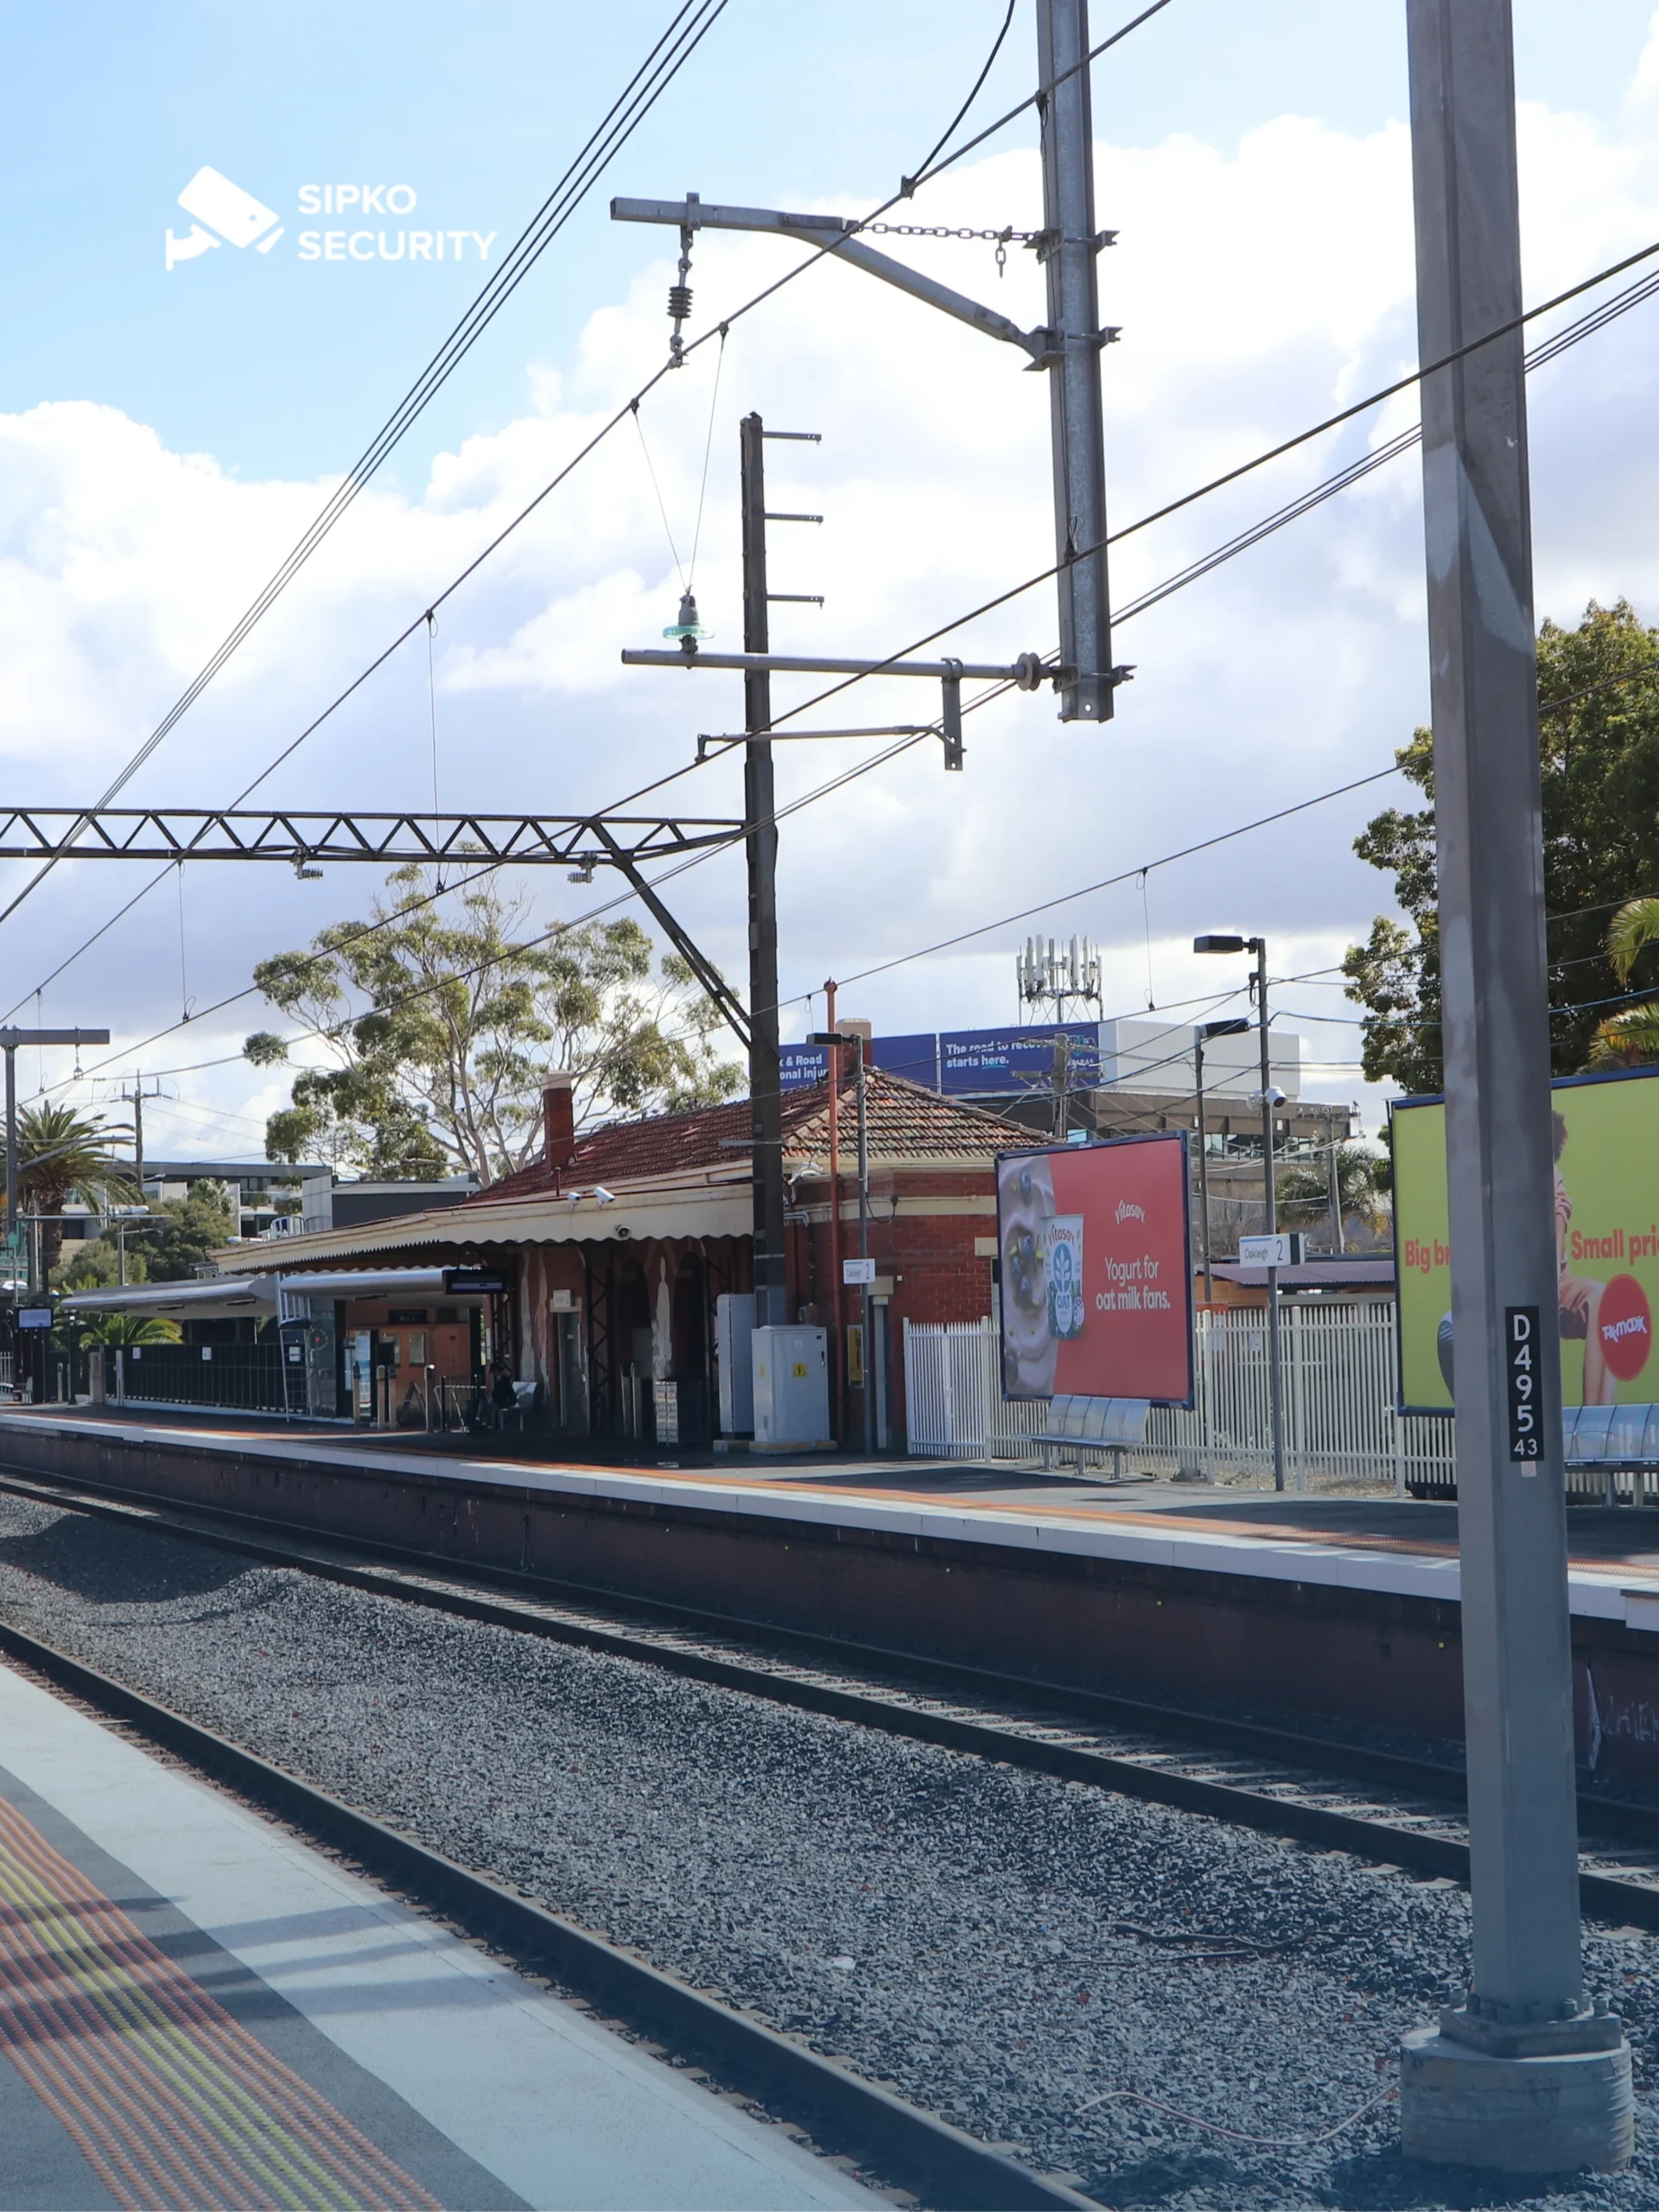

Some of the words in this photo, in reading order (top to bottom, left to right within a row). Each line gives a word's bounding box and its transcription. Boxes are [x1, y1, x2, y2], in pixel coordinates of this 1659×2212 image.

[946, 1043, 967, 1054] The
[969, 1040, 994, 1052] road
[796, 1053, 822, 1065] Road
[946, 1057, 979, 1068] starts
[982, 1054, 1009, 1065] here.
[1276, 1239, 1283, 1261] 2
[1405, 1236, 1431, 1274] Big
[1571, 1228, 1624, 1261] Small
[1629, 1224, 1659, 1267] pri
[1105, 1257, 1142, 1287] Yogurt
[1143, 1255, 1160, 1279] for
[1096, 1288, 1116, 1310] oat
[1117, 1285, 1141, 1310] milk
[1142, 1285, 1171, 1309] fans.
[1513, 1438, 1538, 1456] 43
